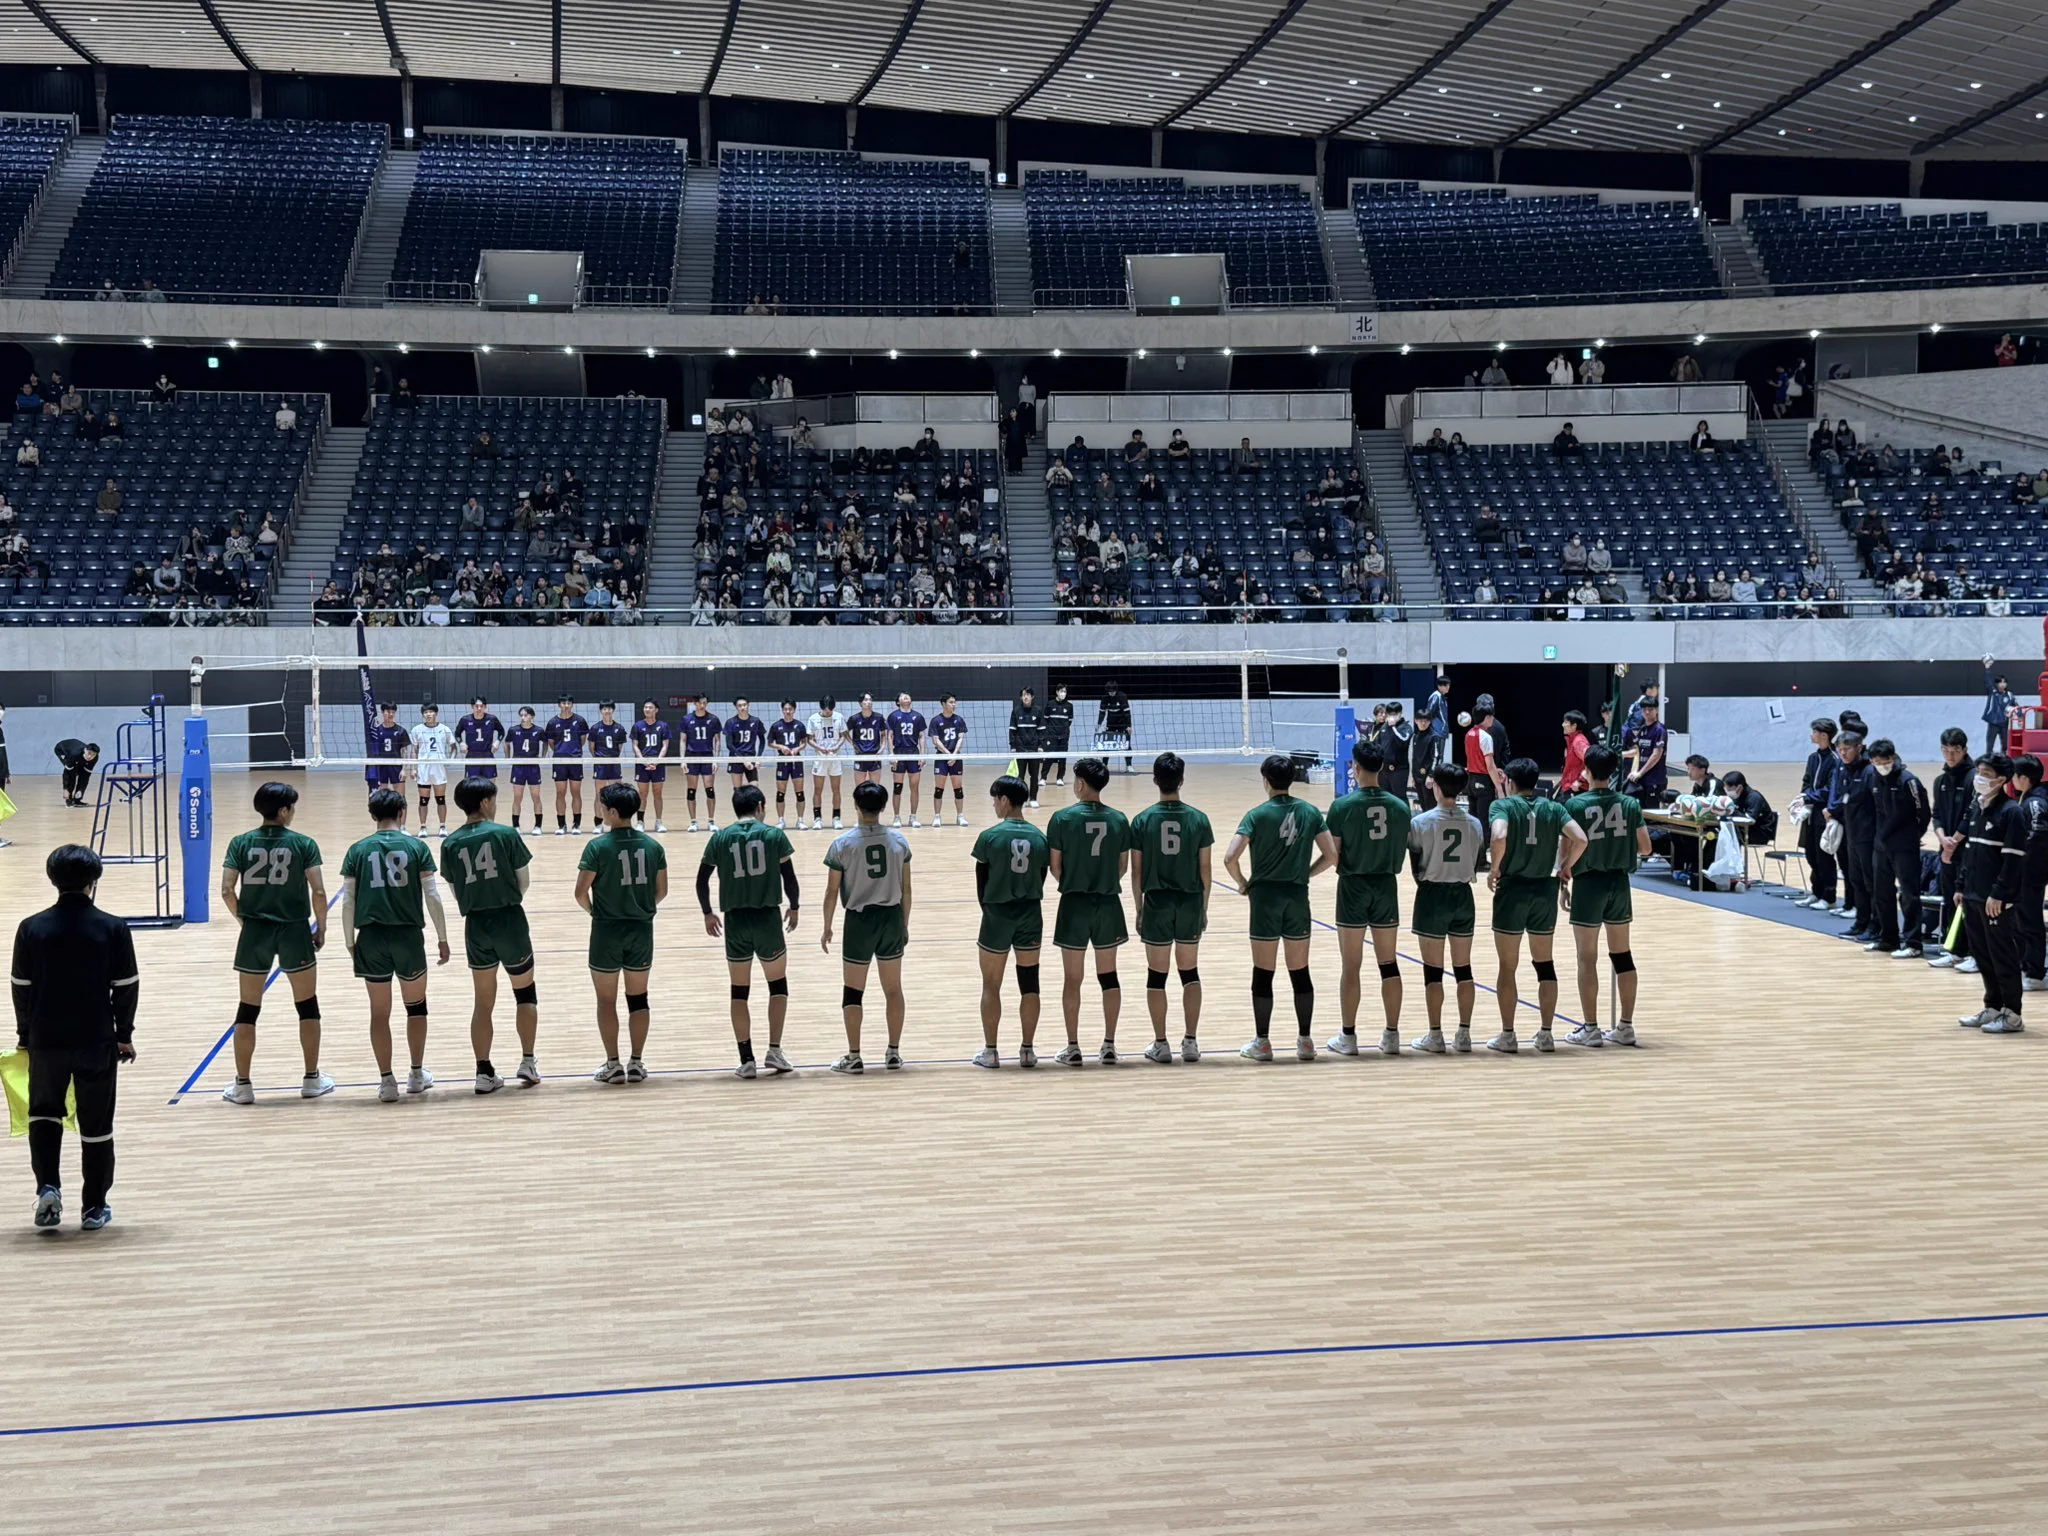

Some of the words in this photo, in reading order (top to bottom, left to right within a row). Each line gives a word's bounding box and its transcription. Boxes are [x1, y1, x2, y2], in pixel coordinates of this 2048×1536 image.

[1356, 316, 1372, 332] 北
[1769, 705, 1782, 719] L
[475, 728, 484, 742] 1
[563, 729, 571, 742] 5
[694, 726, 707, 740] 11
[738, 730, 751, 743] 13
[823, 726, 834, 739] 15
[860, 728, 874, 740] 20
[900, 722, 914, 735] 23
[943, 727, 956, 741] 25
[384, 738, 392, 751] 3
[430, 737, 437, 751] 2
[522, 739, 530, 752] 4
[606, 735, 613, 749] 6
[645, 734, 658, 747] 10
[783, 731, 796, 745] 14
[190, 798, 200, 838] Senoh
[1366, 806, 1388, 840] 3
[1584, 802, 1628, 841] 24
[1279, 810, 1298, 846] 4
[1525, 811, 1538, 845] 1
[1085, 822, 1107, 856] 7
[1160, 820, 1181, 855] 6
[1442, 828, 1463, 862] 2
[457, 841, 499, 885] 14
[729, 839, 767, 879] 10
[865, 844, 887, 879] 9
[1010, 838, 1030, 874] 8
[243, 847, 293, 885] 28
[367, 850, 409, 888] 18
[618, 848, 648, 886] 11
